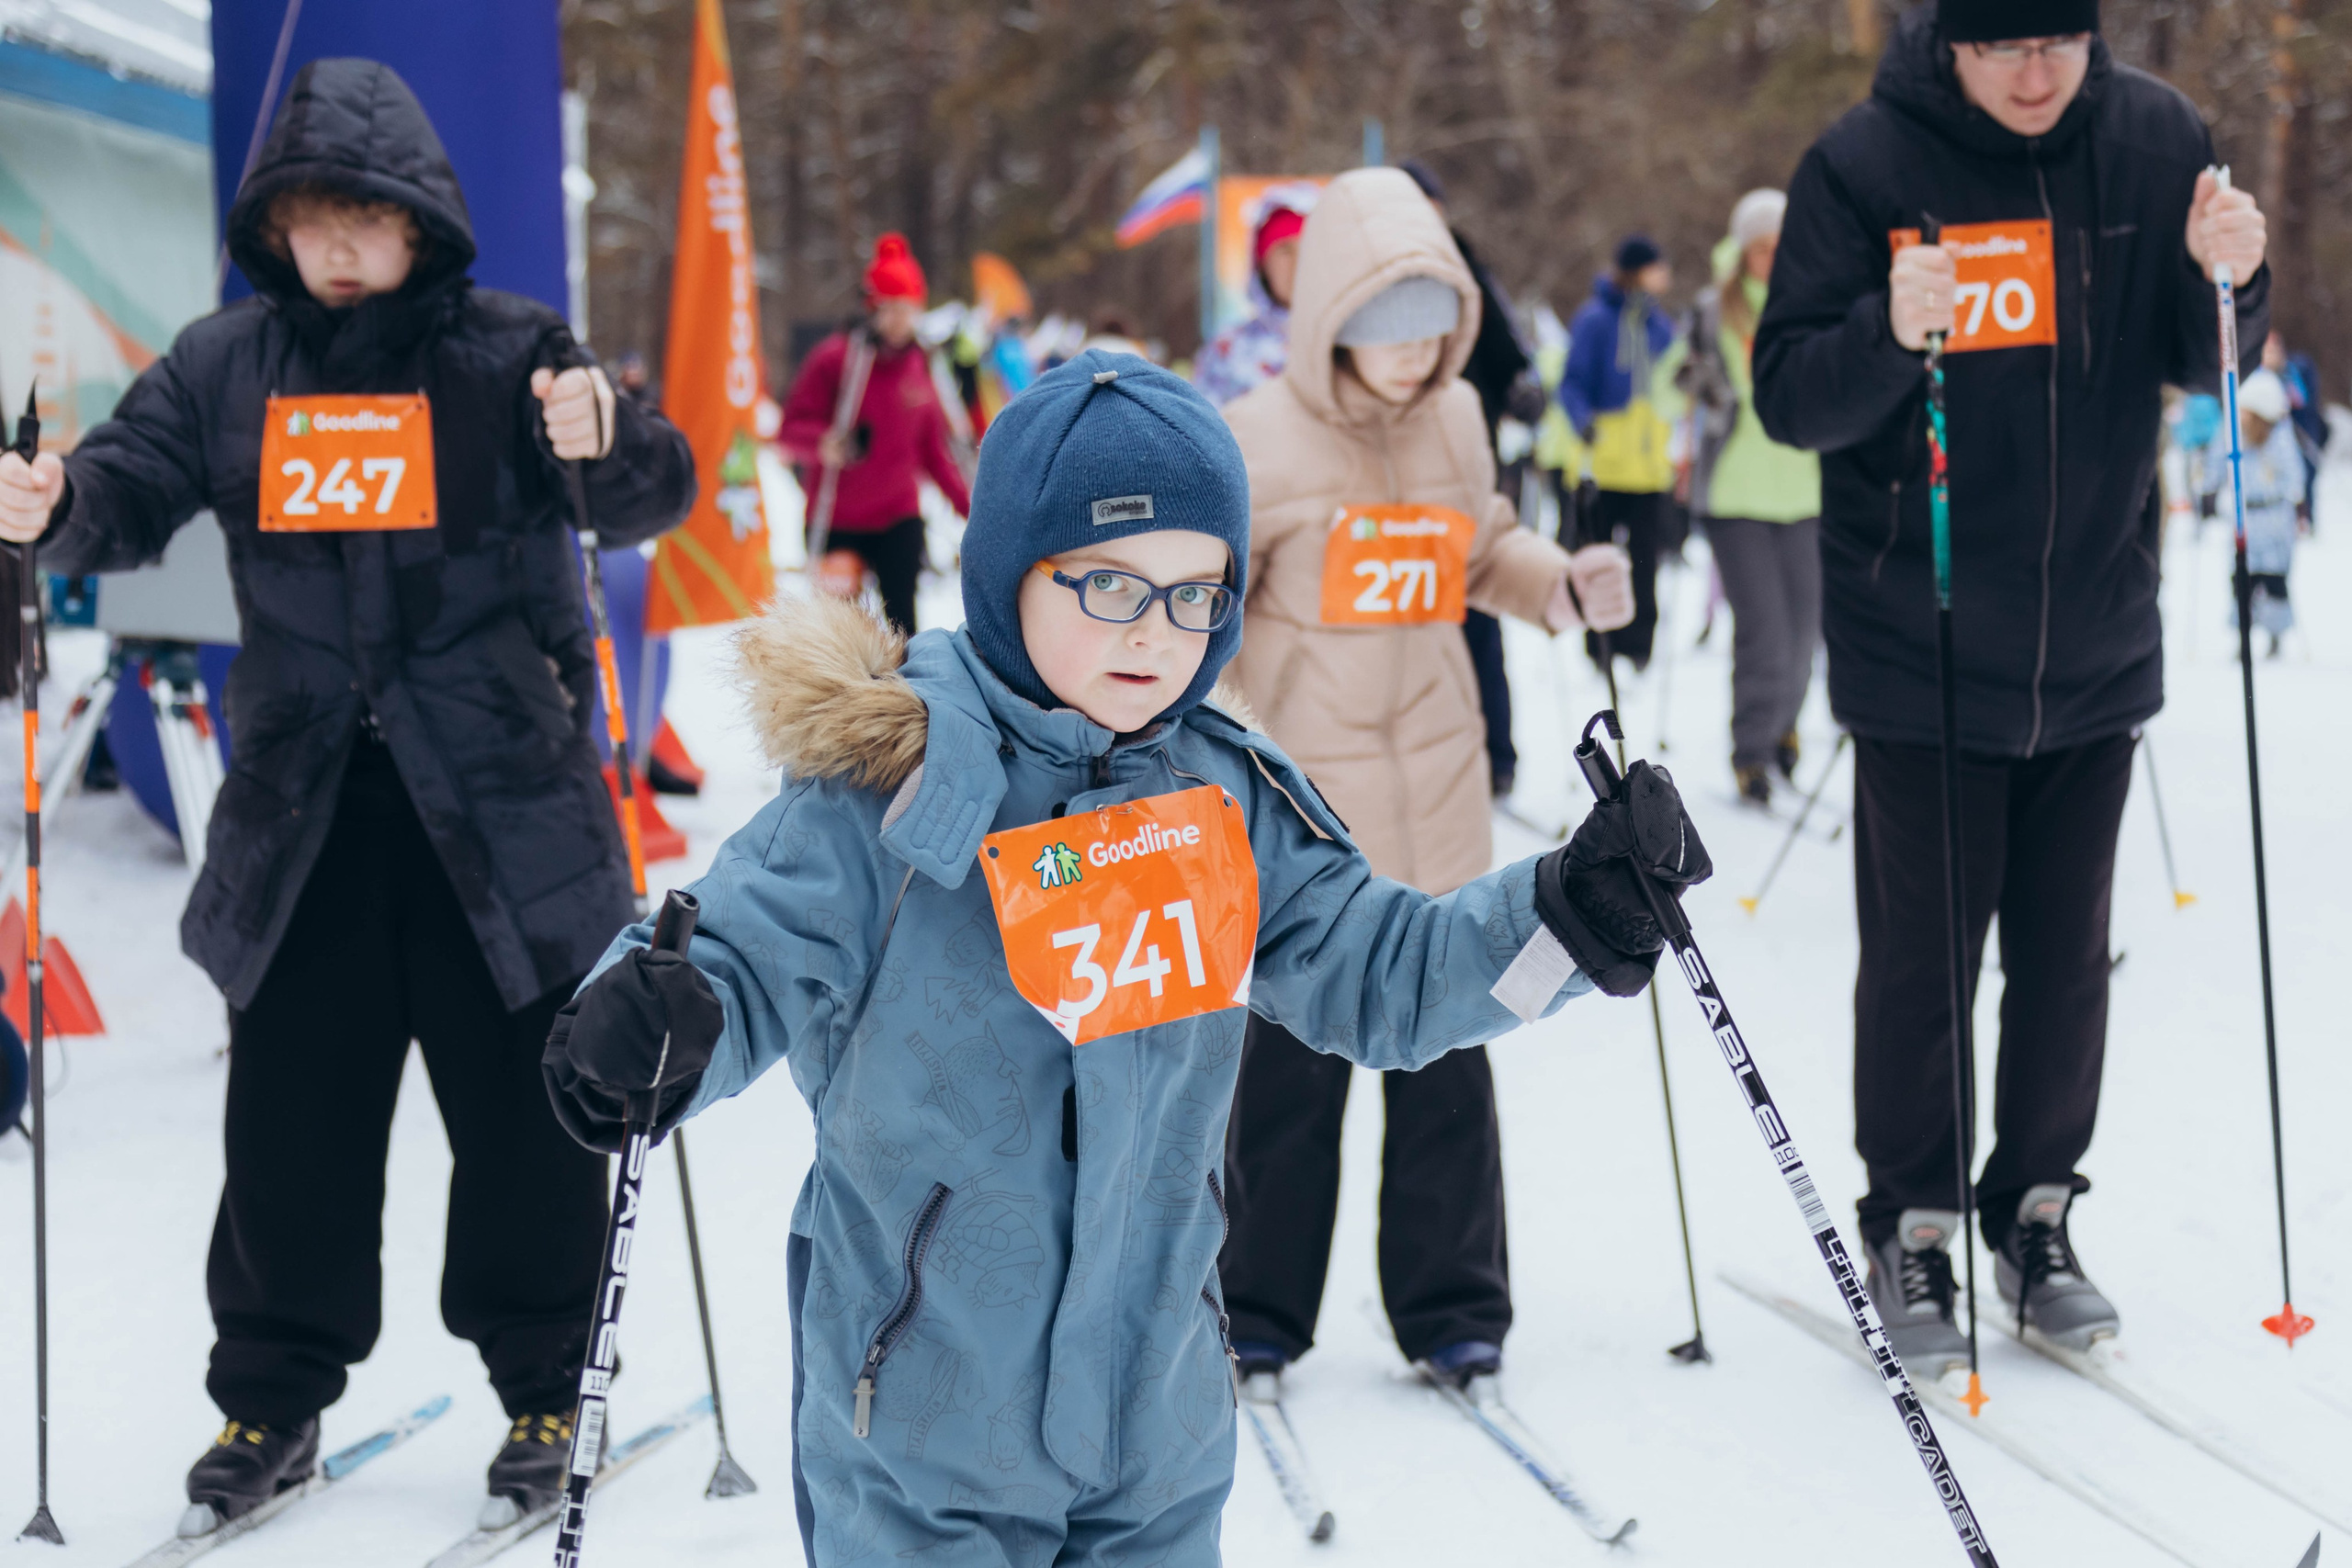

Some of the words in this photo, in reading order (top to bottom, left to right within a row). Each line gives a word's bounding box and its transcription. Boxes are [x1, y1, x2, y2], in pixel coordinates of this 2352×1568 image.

[1949, 278, 2036, 337] 70
[312, 410, 401, 432] Goodline
[281, 457, 406, 515] 247
[1110, 501, 1147, 513] sokoke
[1353, 559, 1436, 612] 271
[1088, 823, 1201, 867] Goodline
[1052, 899, 1206, 1018] 341
[911, 1037, 946, 1091] NIKASTYLE
[1678, 947, 1786, 1146] SABLE
[594, 1134, 650, 1369] SABLE
[1904, 1412, 1988, 1554] CADET
